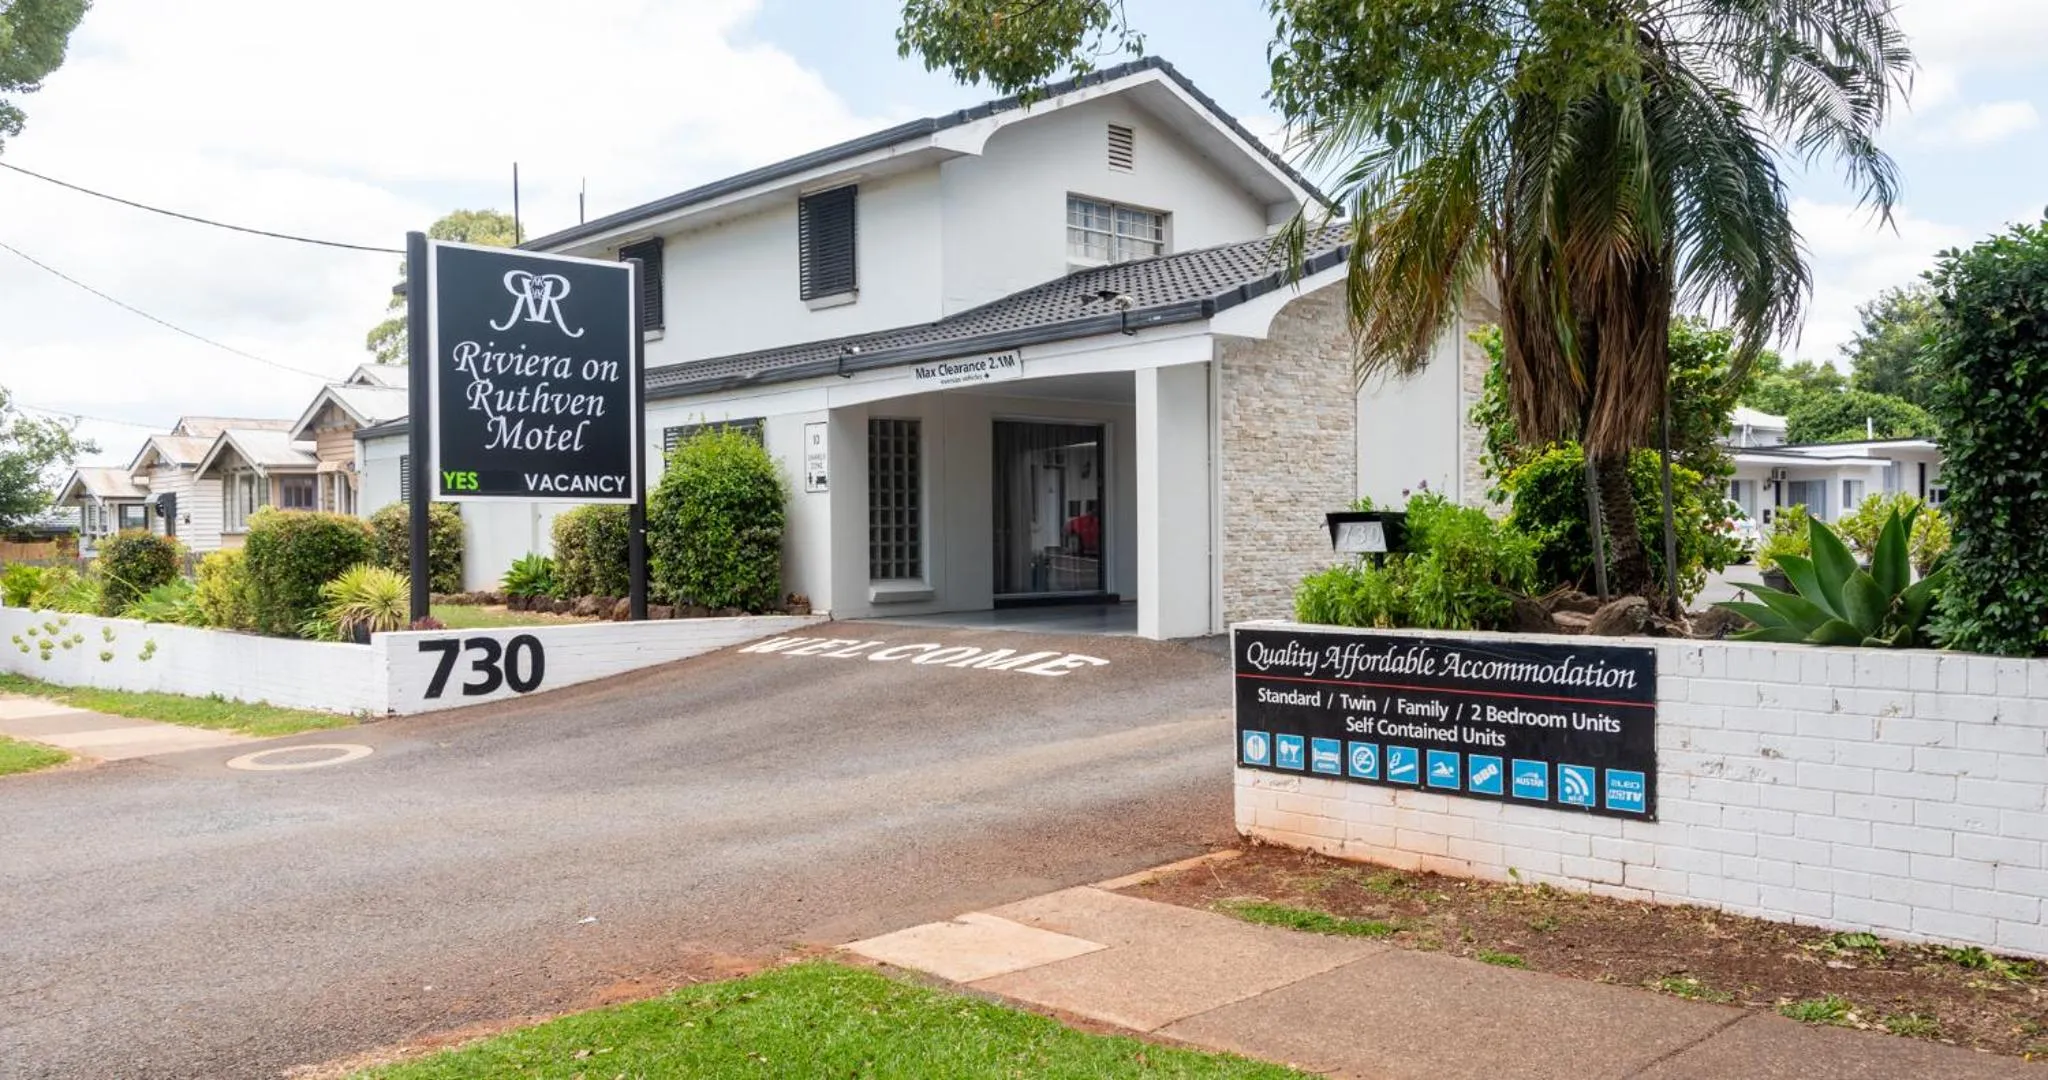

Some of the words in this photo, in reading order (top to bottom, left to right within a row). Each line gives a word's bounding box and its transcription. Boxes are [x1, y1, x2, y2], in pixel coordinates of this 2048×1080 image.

[453, 340, 572, 382] Riviera
[582, 358, 619, 382] on
[915, 367, 936, 380] Max
[938, 360, 987, 376] Clearance
[988, 354, 1015, 370] 2.1M
[466, 379, 605, 418] Ruthven
[484, 415, 590, 451] Motel
[443, 471, 479, 490] YES
[524, 473, 625, 492] VACANCY
[418, 634, 545, 699] 730
[738, 636, 1110, 676] WELCOME
[1247, 640, 1319, 676] Quality
[1321, 643, 1435, 679] Affordable
[1439, 652, 1638, 689] Accommodation
[1258, 687, 1321, 707] Standard
[1340, 694, 1376, 712] Twin
[1397, 698, 1449, 721] Family
[1471, 704, 1482, 721] 2
[1487, 705, 1567, 729] Bedroom
[1572, 712, 1621, 733] Units
[1346, 716, 1375, 734] Self
[1377, 719, 1458, 742] Contained
[1463, 727, 1506, 747] Units
